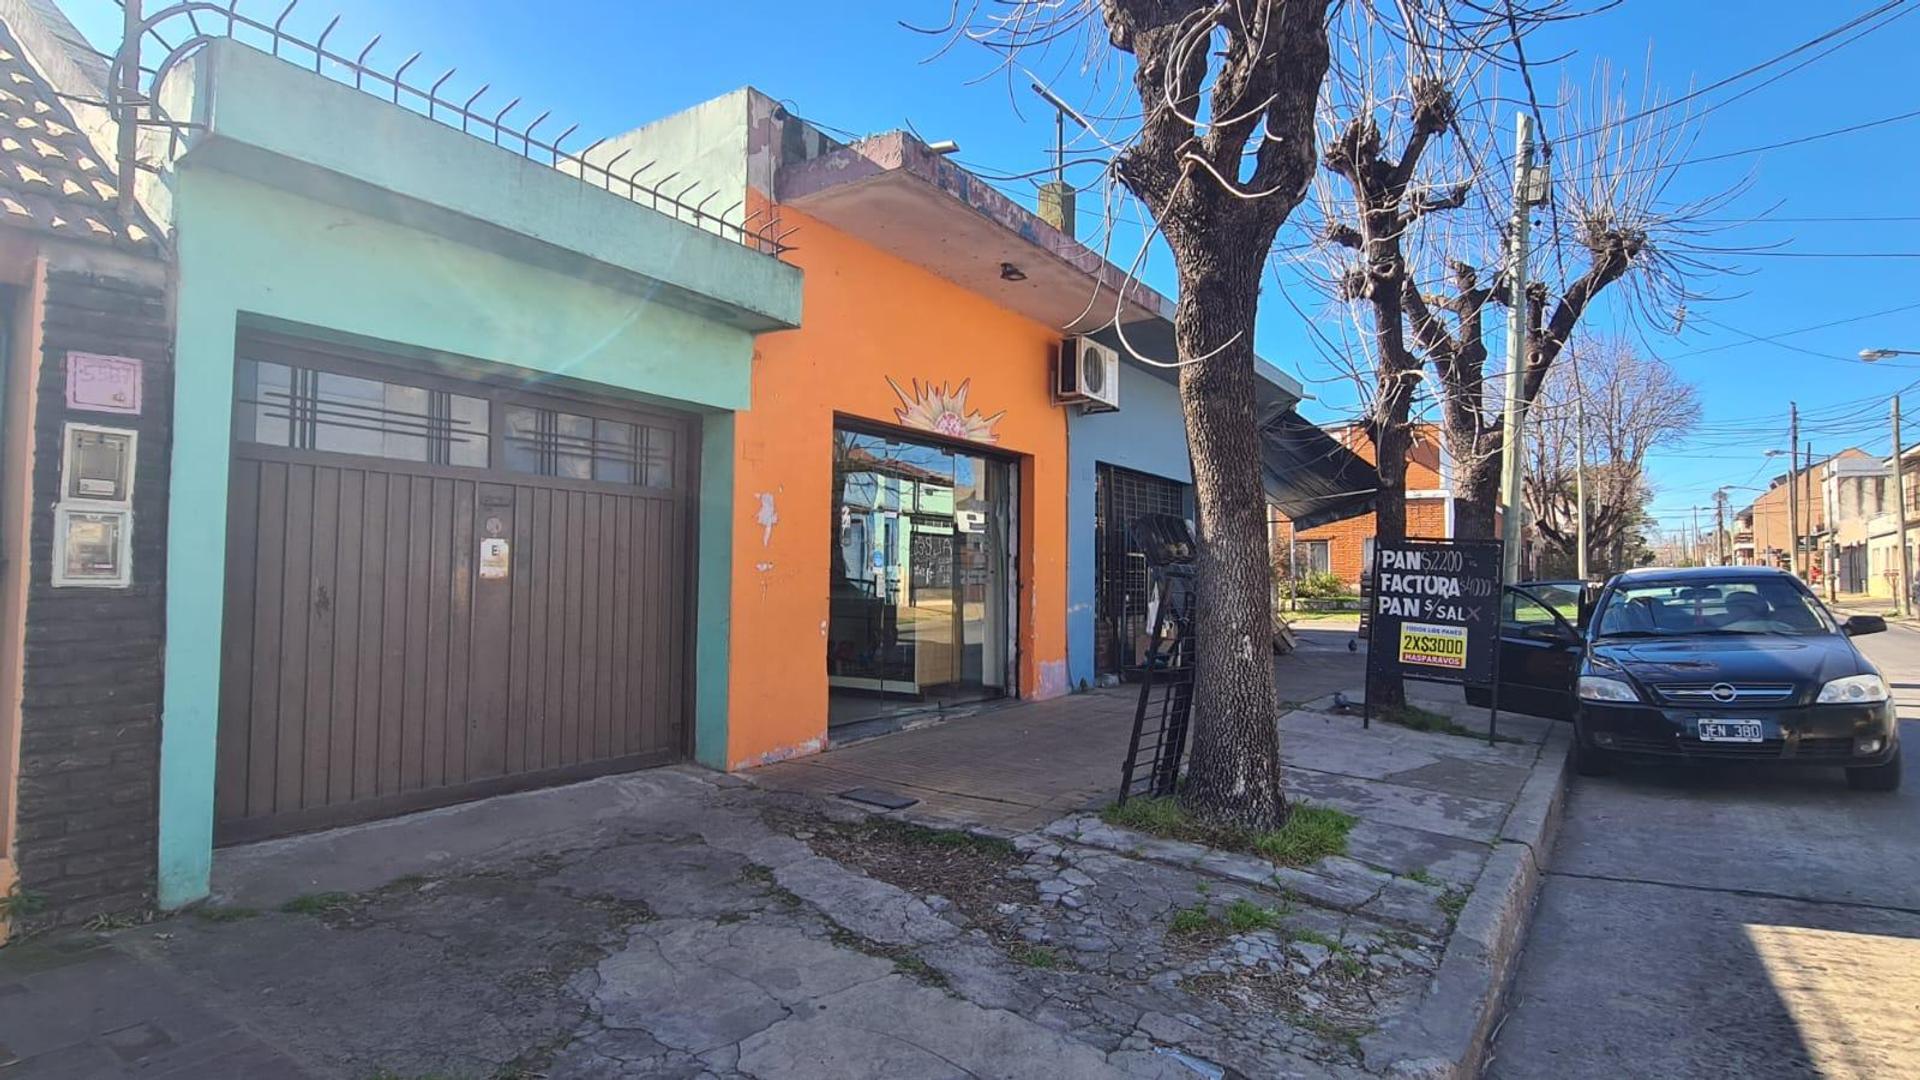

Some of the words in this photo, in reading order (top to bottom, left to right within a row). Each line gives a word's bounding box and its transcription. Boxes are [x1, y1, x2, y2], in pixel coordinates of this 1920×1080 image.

[1382, 550, 1421, 570] PAN
[1421, 551, 1463, 573] $2200
[1380, 573, 1460, 599] FACTURA
[1378, 596, 1420, 617] PAN
[1403, 635, 1463, 655] 2X$3000
